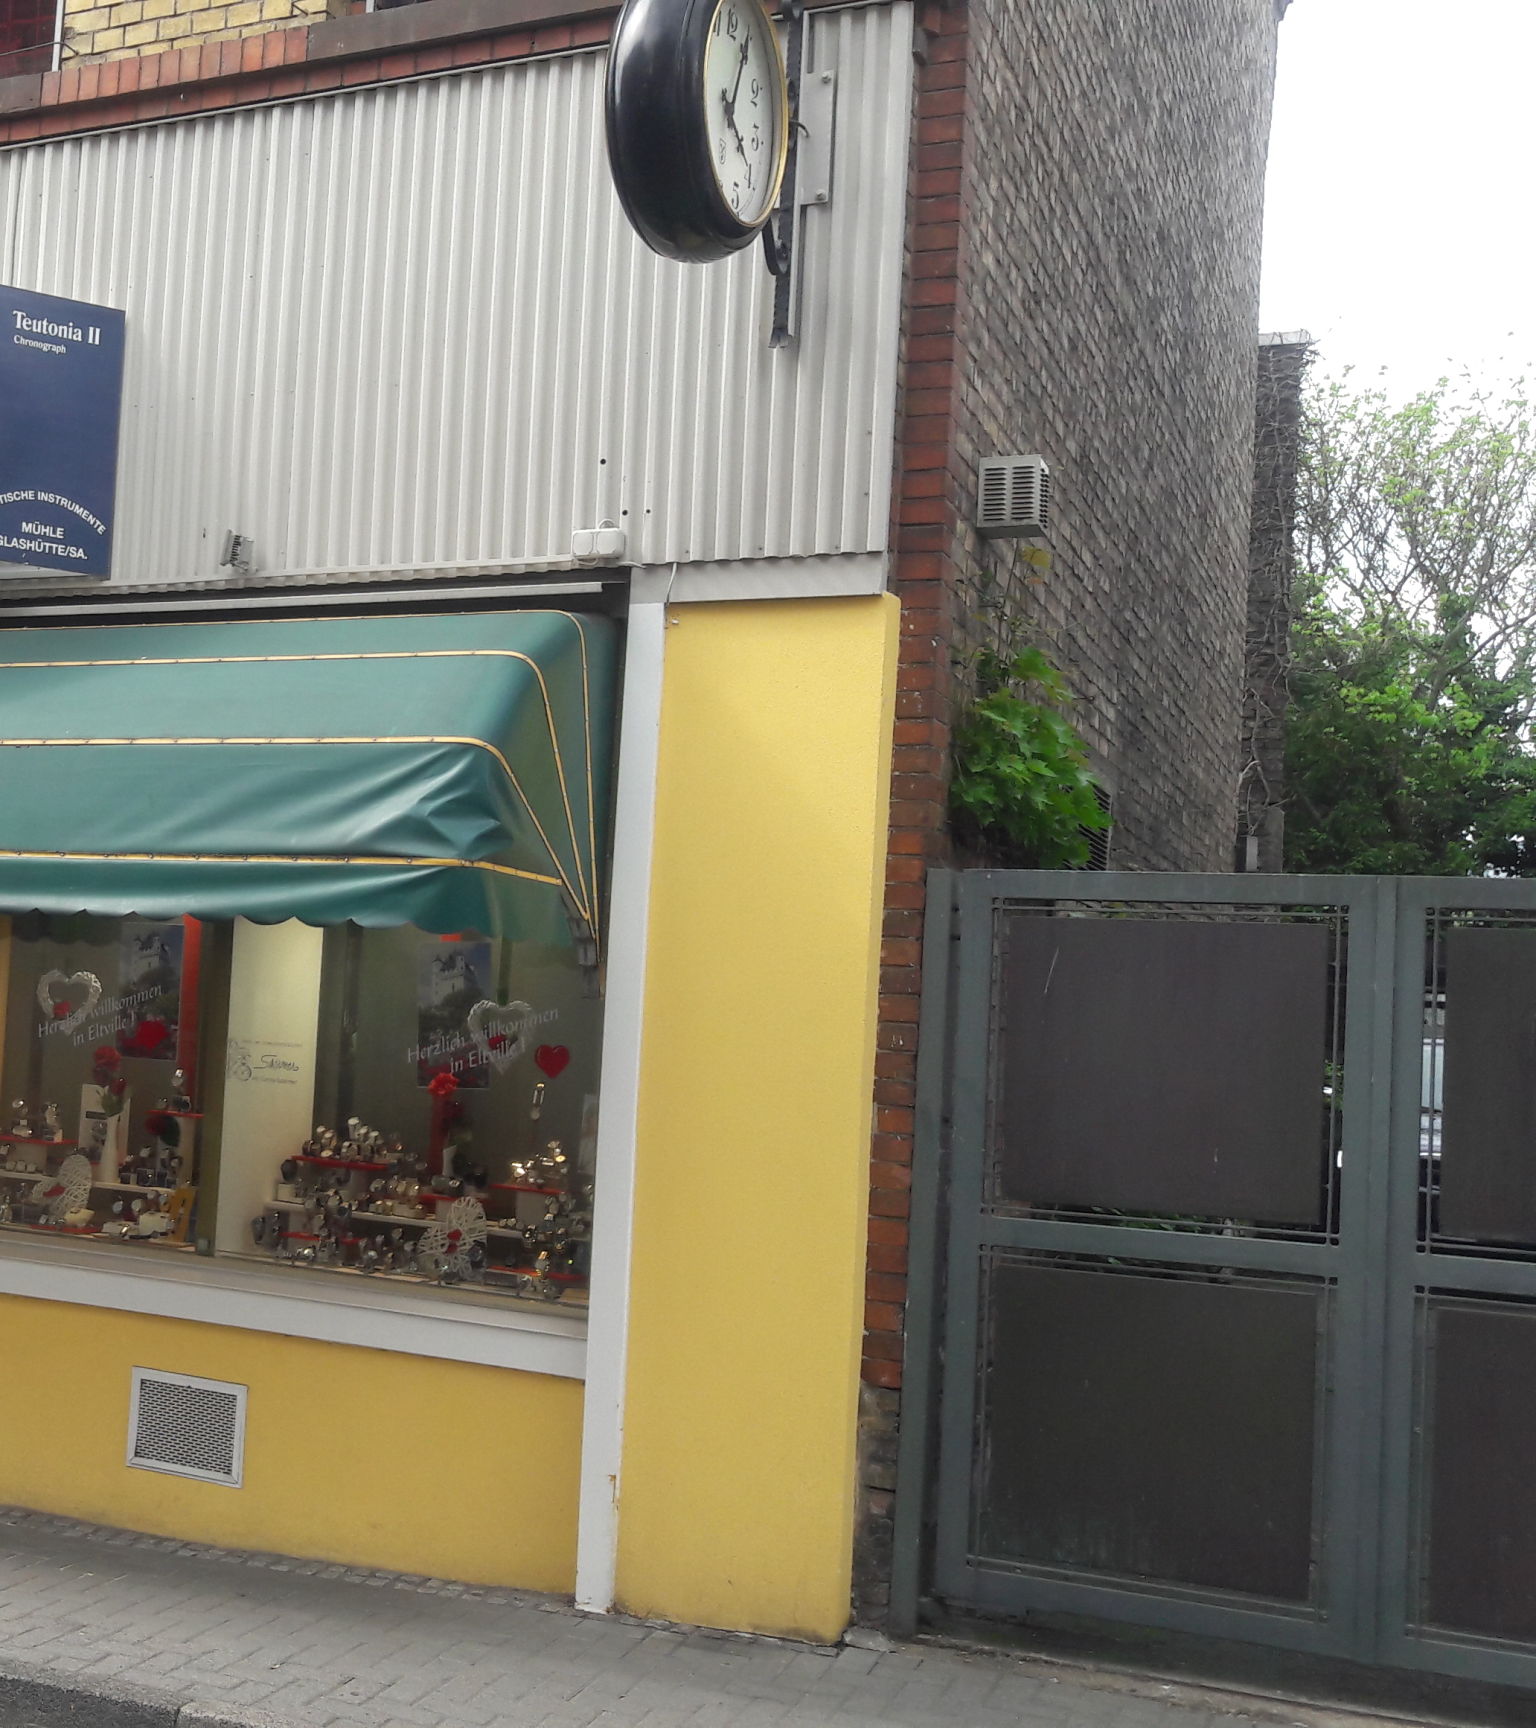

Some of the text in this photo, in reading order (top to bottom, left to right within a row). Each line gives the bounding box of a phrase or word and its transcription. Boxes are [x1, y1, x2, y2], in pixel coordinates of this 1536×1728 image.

[751, 78, 762, 108] 2
[751, 123, 763, 151] 3
[731, 182, 739, 209] 5
[12, 310, 101, 345] Teutonia II
[13, 334, 66, 354] Chronograph
[37, 491, 107, 535] INSTRUMENTE
[21, 521, 64, 539] MÜHLE
[90, 985, 162, 1018] willkommen
[73, 1032, 84, 1047] in
[88, 1014, 126, 1041] Eltville
[407, 1030, 465, 1063] Herzlich
[450, 1057, 464, 1074] in
